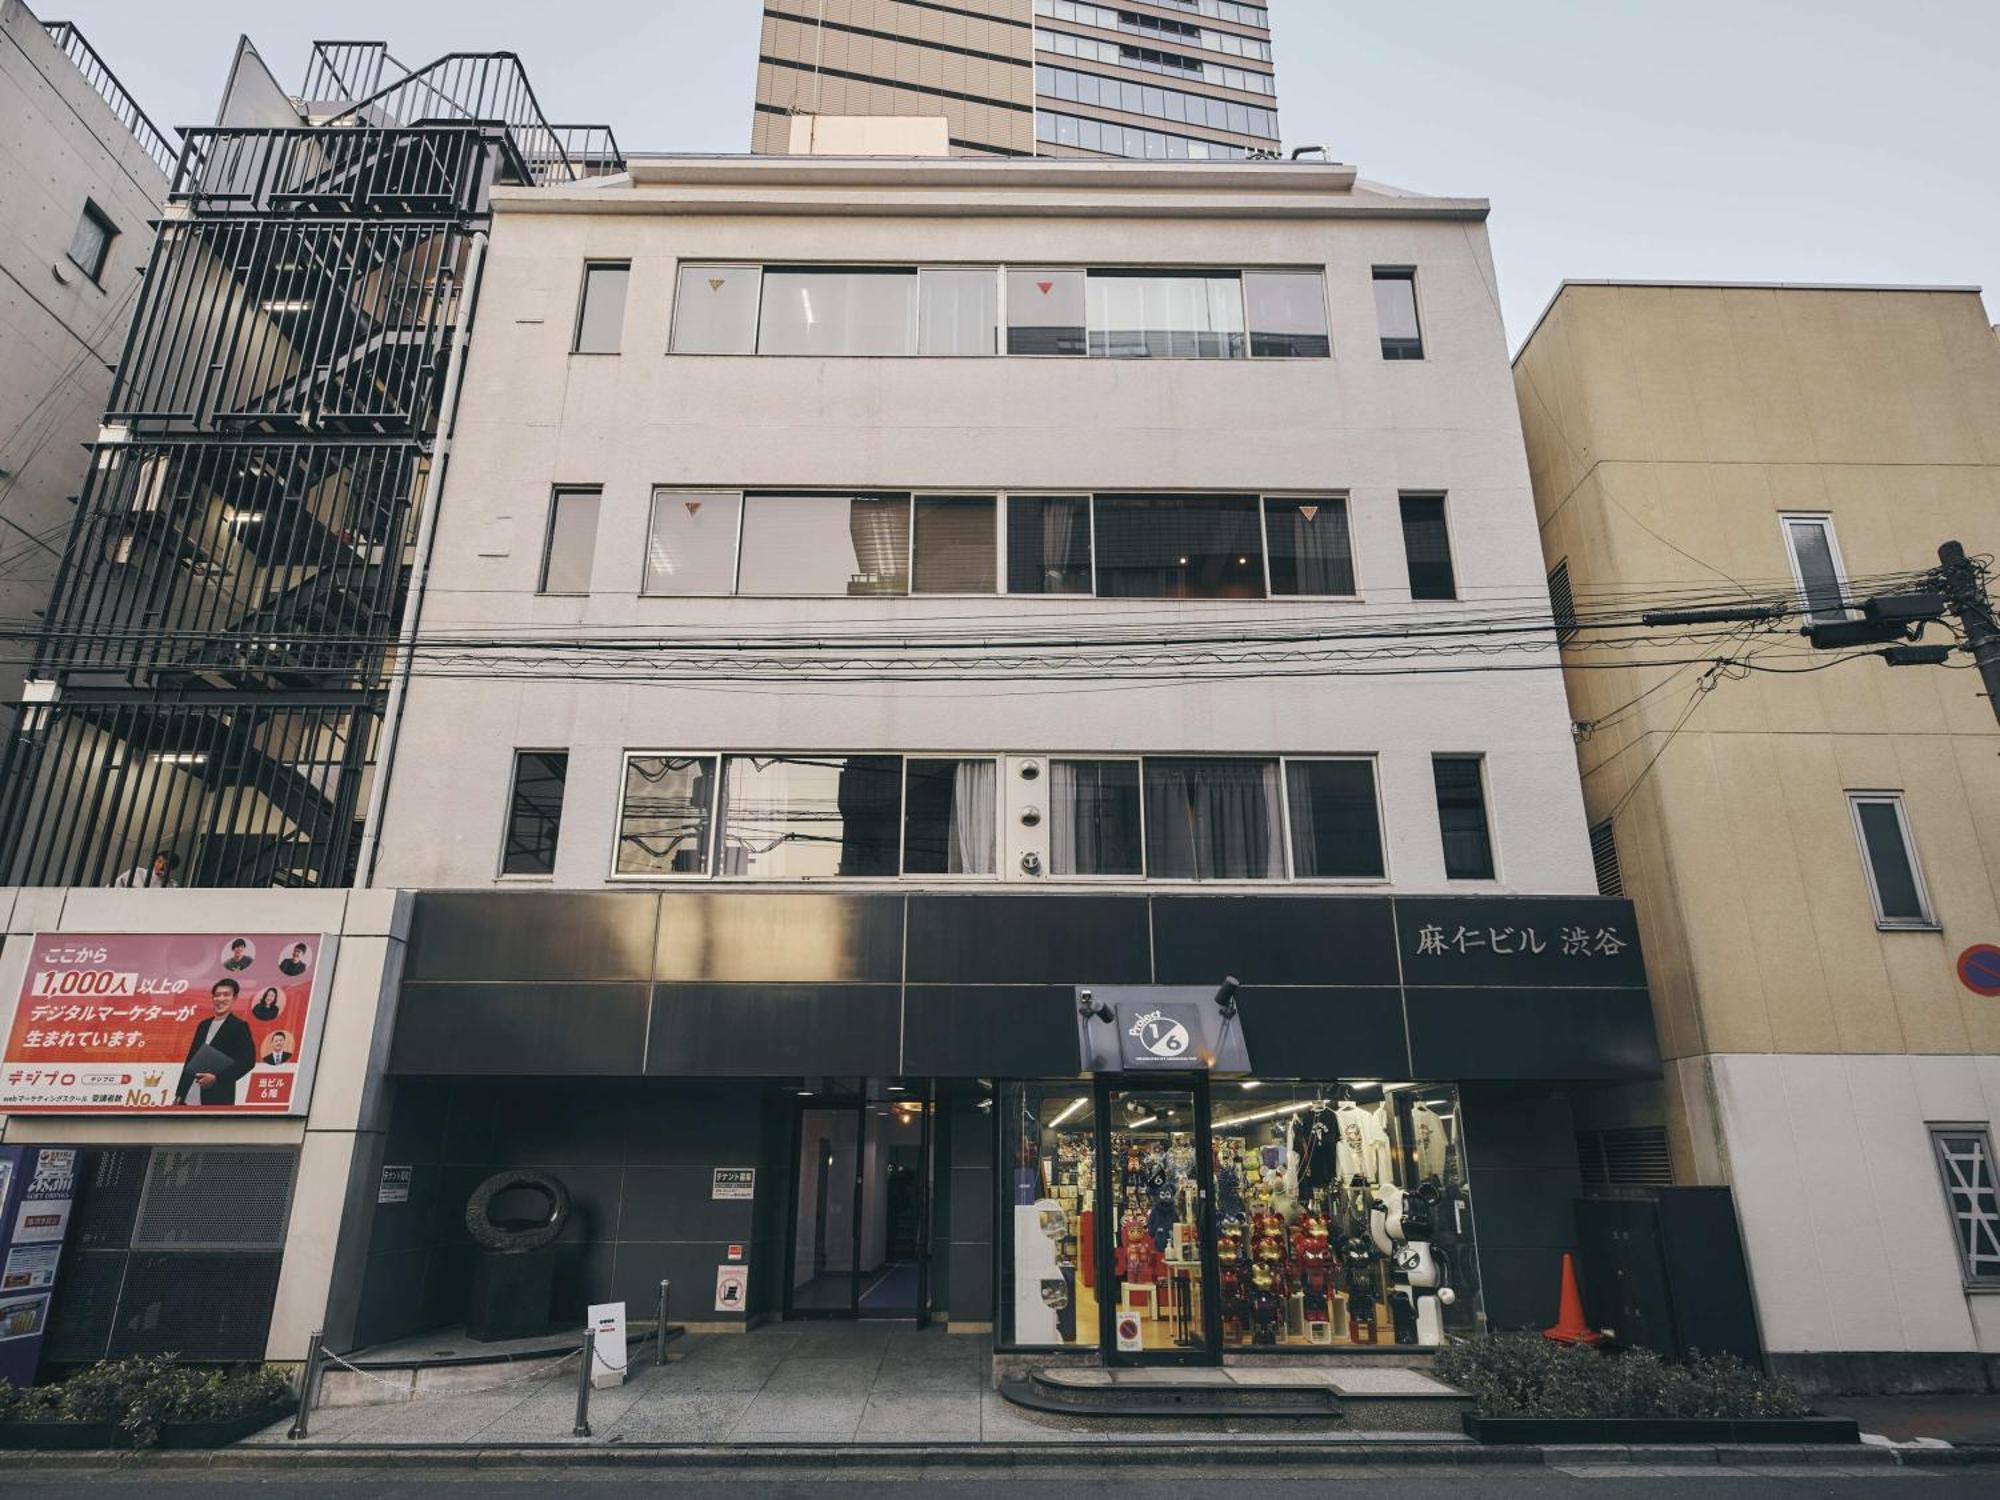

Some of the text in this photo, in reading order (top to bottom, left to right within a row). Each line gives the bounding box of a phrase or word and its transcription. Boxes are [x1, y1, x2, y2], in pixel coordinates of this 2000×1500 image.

[1416, 924, 1628, 957] 麻仁ビル 渋谷
[44, 948, 108, 963] ここから
[42, 971, 189, 995] 1,000人 以上の
[31, 1005, 198, 1022] デジタルマーケターが
[1128, 1010, 1161, 1036] Project
[23, 1031, 145, 1048] 生まれています。
[8, 1070, 76, 1086] デジプロ
